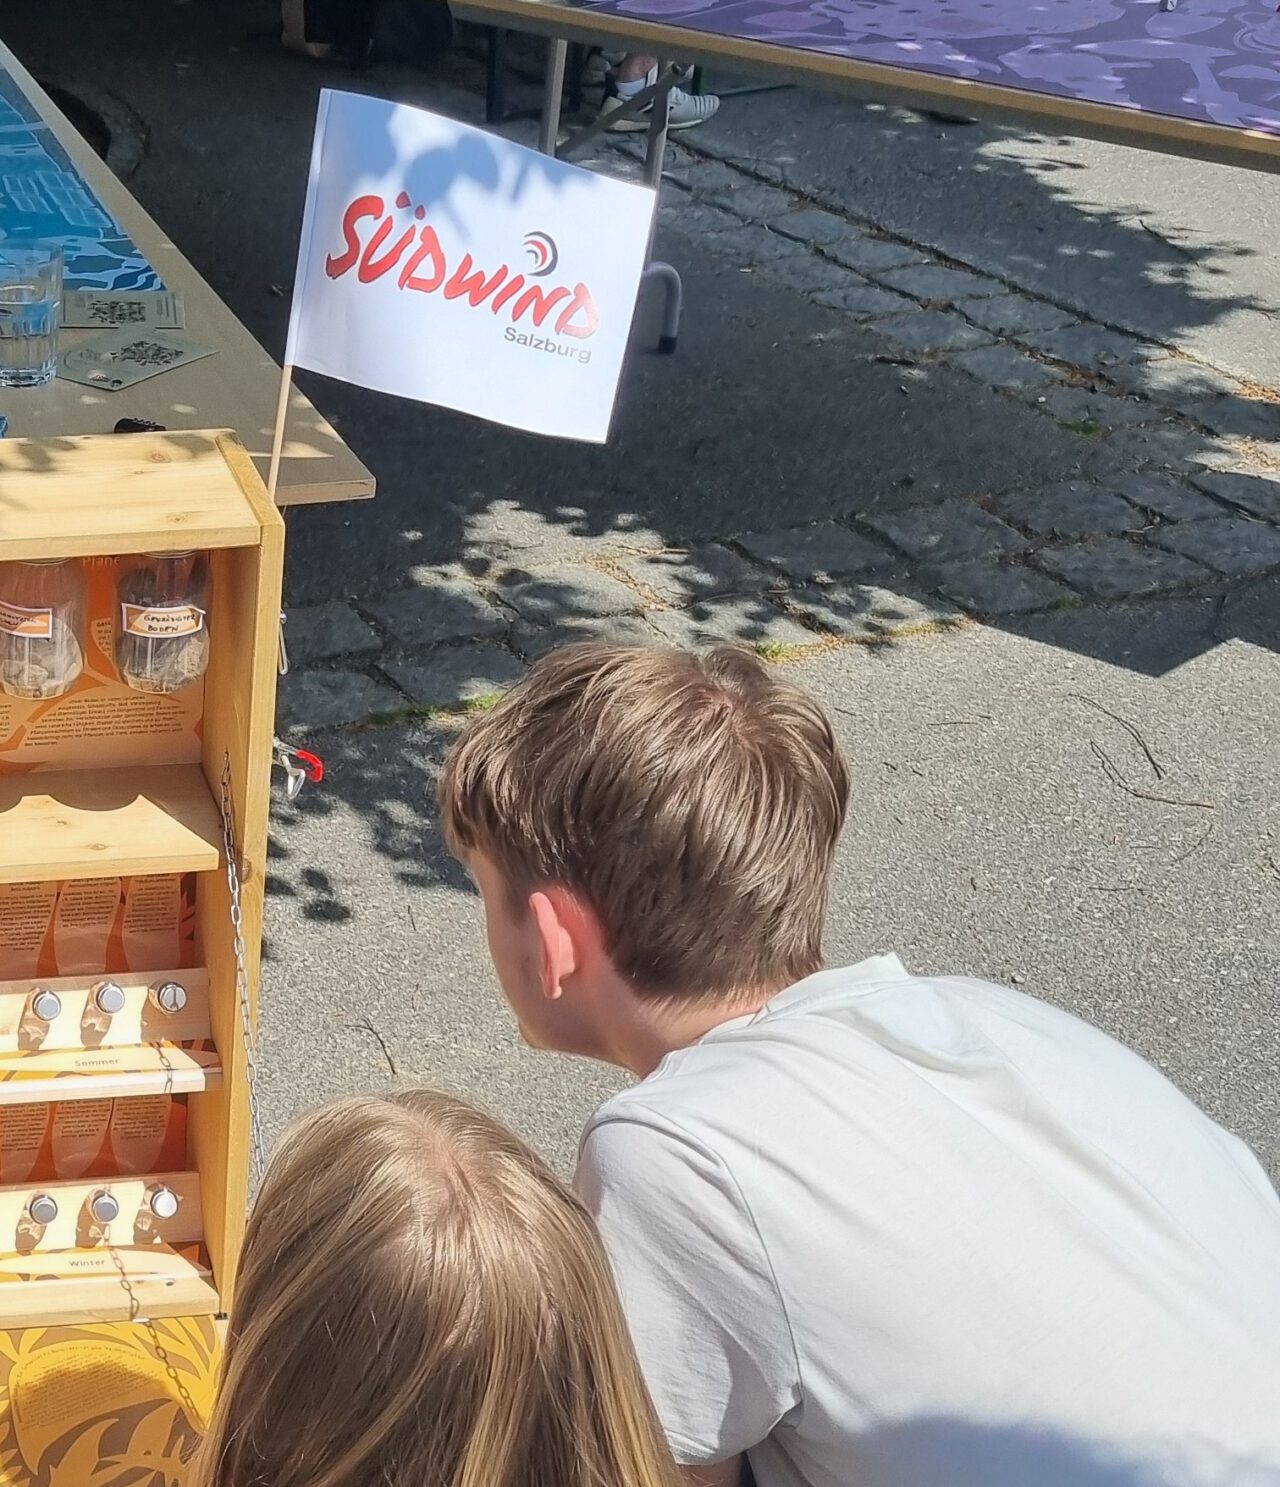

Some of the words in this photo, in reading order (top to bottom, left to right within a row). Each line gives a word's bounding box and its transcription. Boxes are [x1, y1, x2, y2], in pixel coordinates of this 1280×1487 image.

[325, 191, 599, 339] SÜDWIND
[504, 326, 592, 364] Salzburg
[74, 1059, 120, 1067] Sommer
[68, 1259, 105, 1267] Winter
